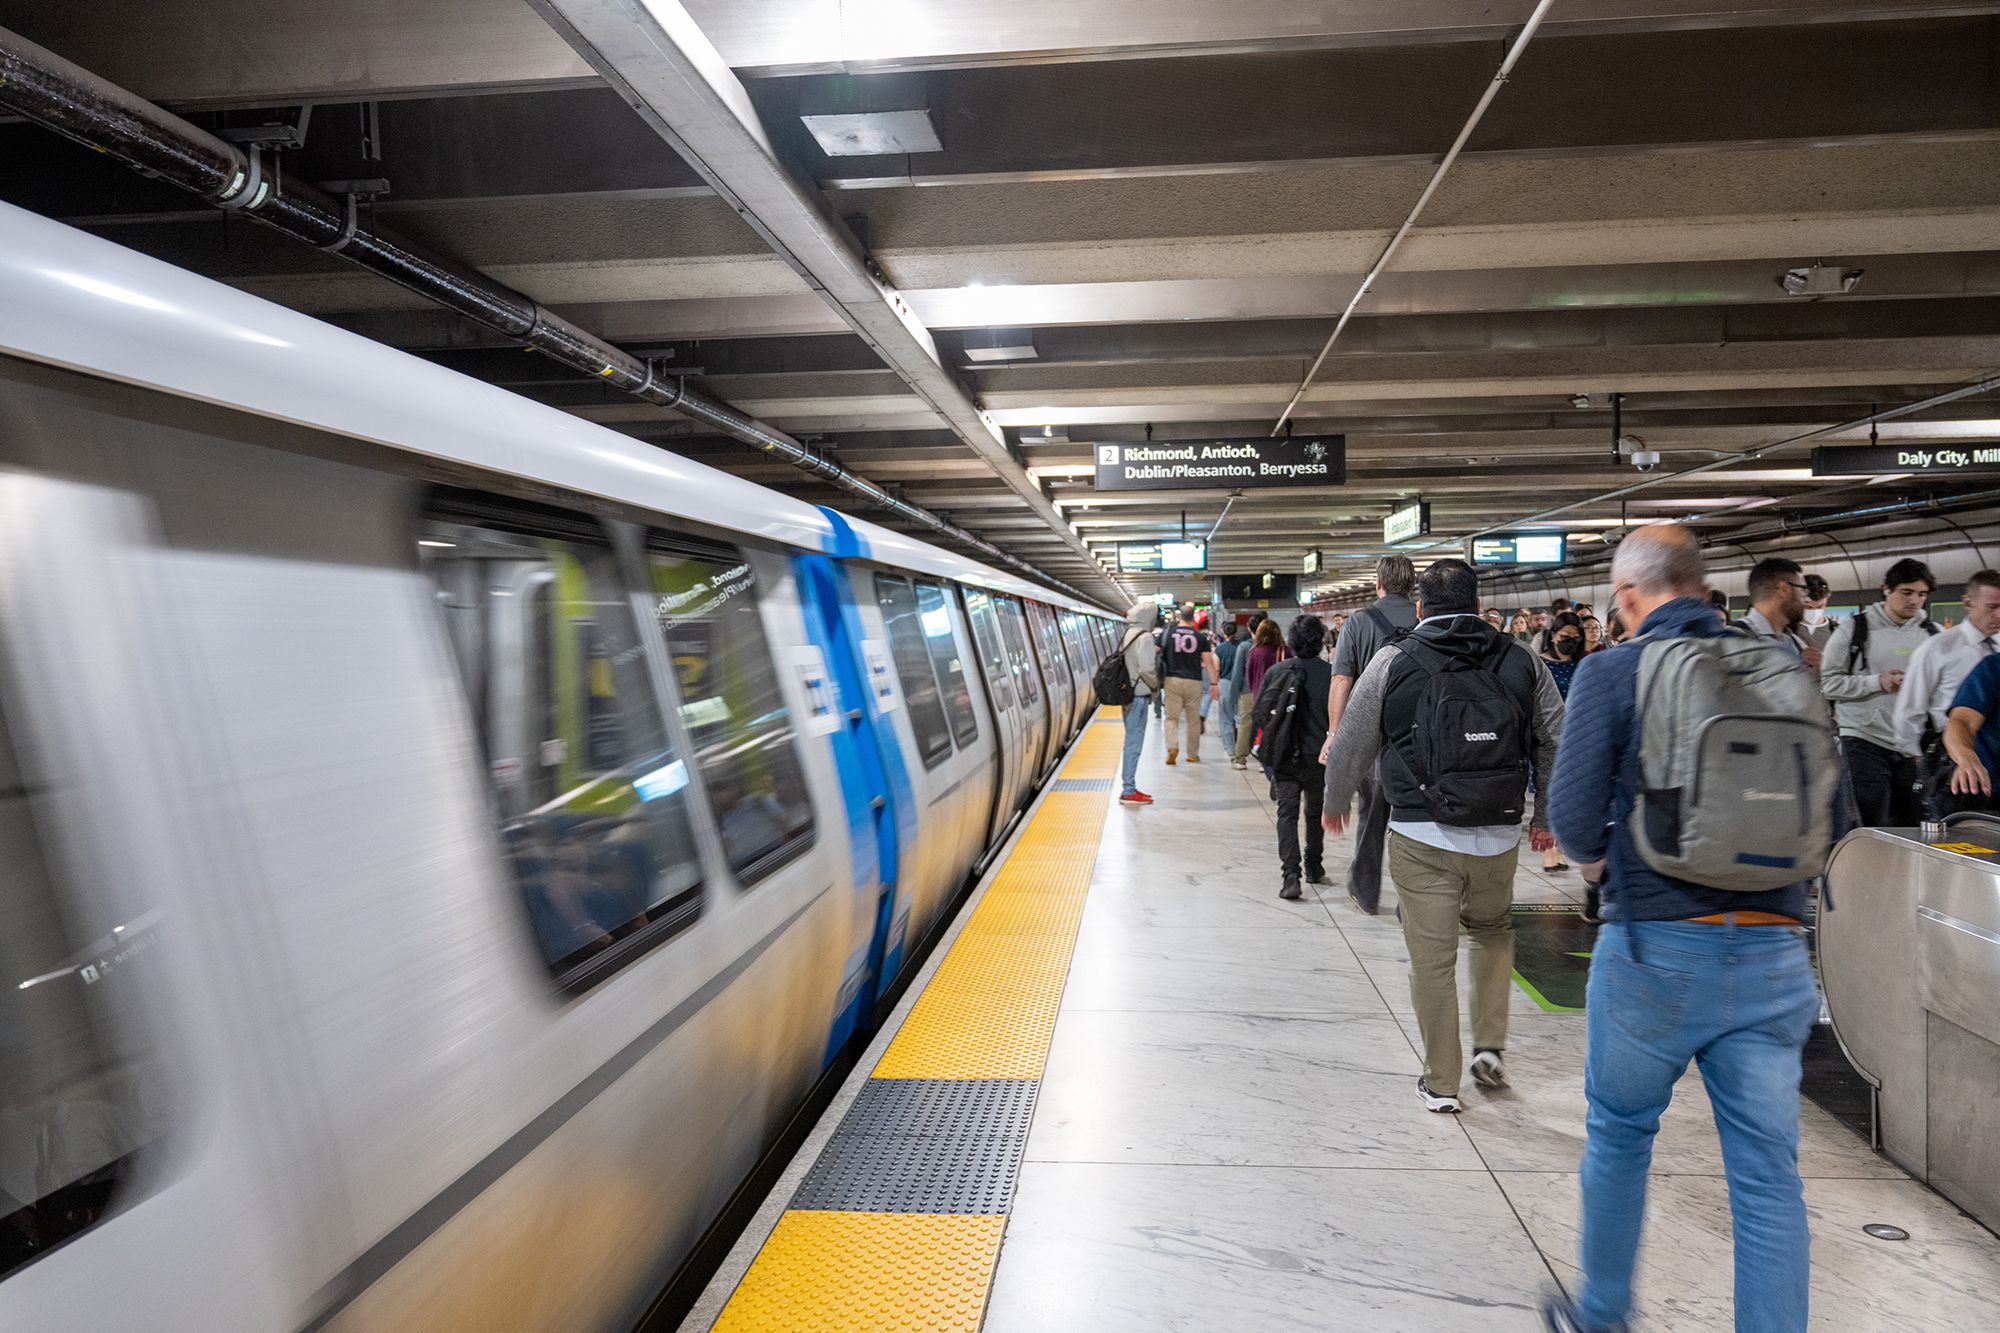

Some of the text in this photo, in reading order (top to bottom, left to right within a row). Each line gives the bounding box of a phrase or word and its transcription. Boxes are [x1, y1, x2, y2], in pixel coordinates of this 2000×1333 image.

[1105, 449, 1113, 462] 2
[1124, 444, 1260, 461] Richmond, Antioch,
[1898, 451, 1932, 467] Daly
[1935, 450, 1970, 467] City,
[1125, 462, 1328, 479] Dublin/Pleasanton, Berryessa
[1171, 633, 1198, 654] 10
